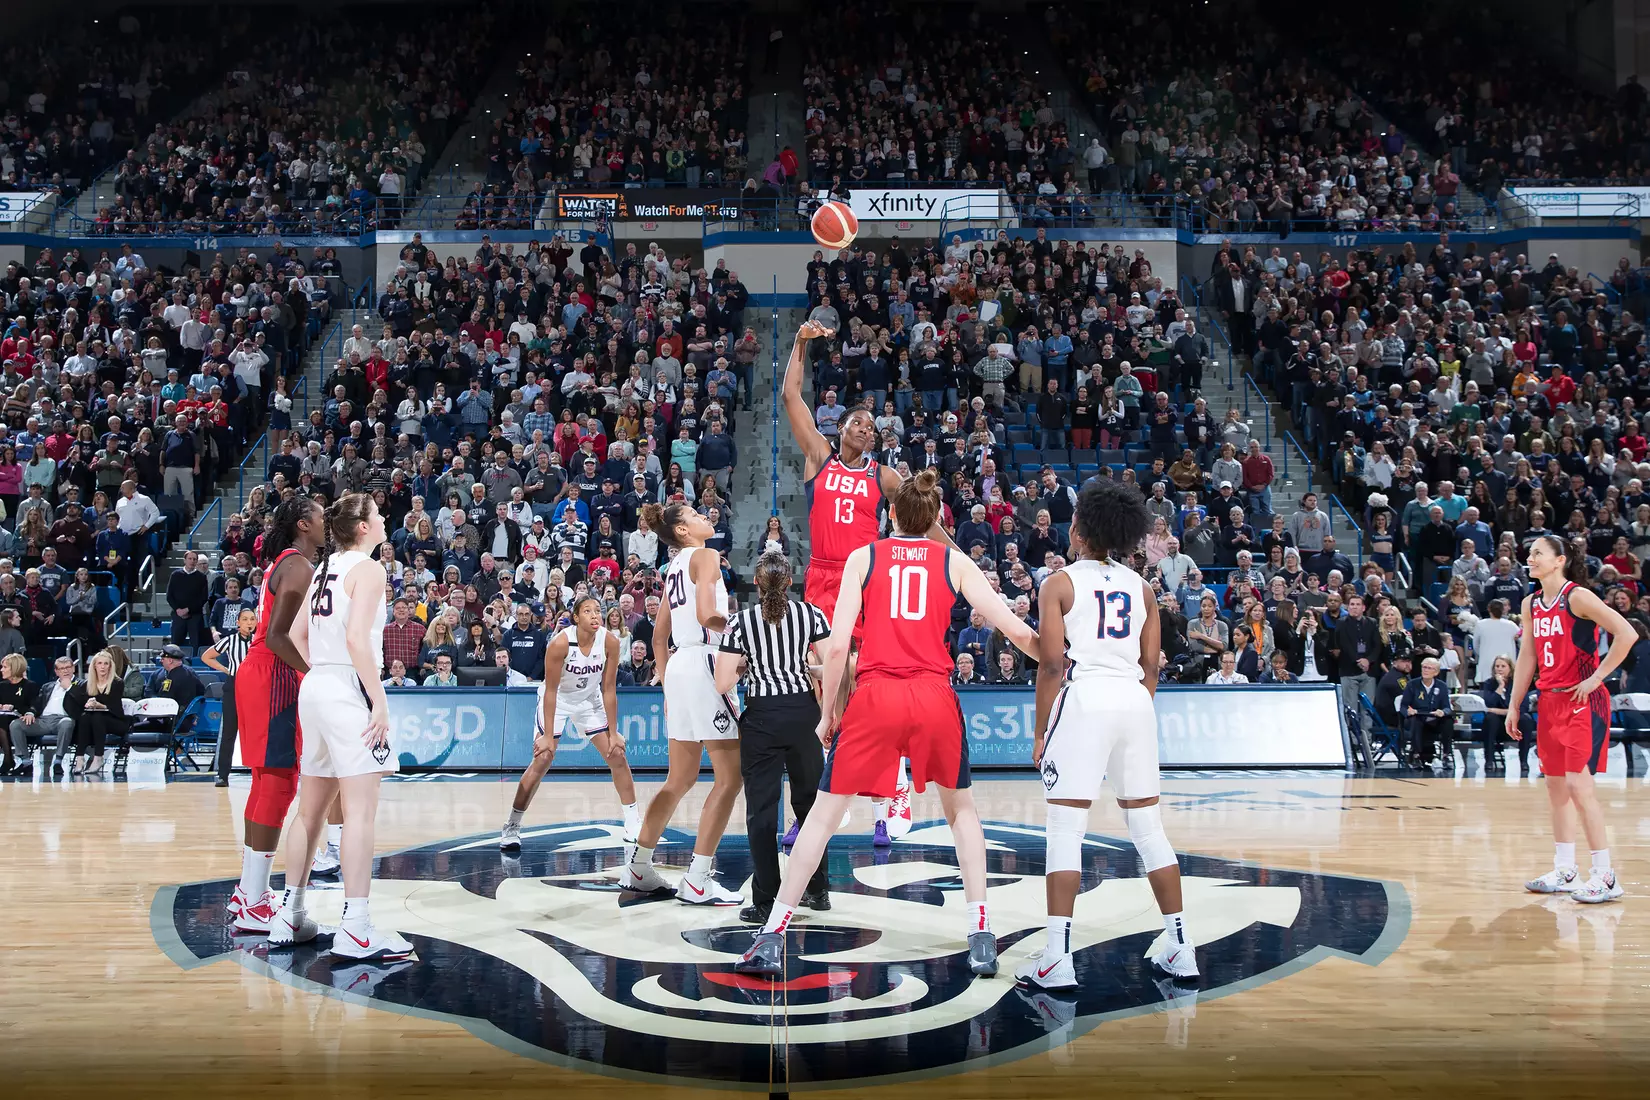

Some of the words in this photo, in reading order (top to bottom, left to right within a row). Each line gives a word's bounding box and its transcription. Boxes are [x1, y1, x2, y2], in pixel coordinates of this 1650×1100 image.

[634, 204, 738, 218] WatchForMeCT.org
[868, 192, 938, 217] xfinity
[194, 238, 218, 250] 114
[1333, 235, 1358, 247] 117
[824, 472, 868, 498] USA
[834, 497, 855, 524] 13
[891, 545, 928, 561] STEWART
[310, 573, 339, 617] 25
[668, 569, 687, 610] 20
[888, 564, 928, 621] 10
[1094, 590, 1131, 639] 13
[1533, 615, 1564, 638] USA
[1543, 641, 1555, 668] 6
[565, 663, 603, 675] UCONN
[576, 677, 588, 689] 3
